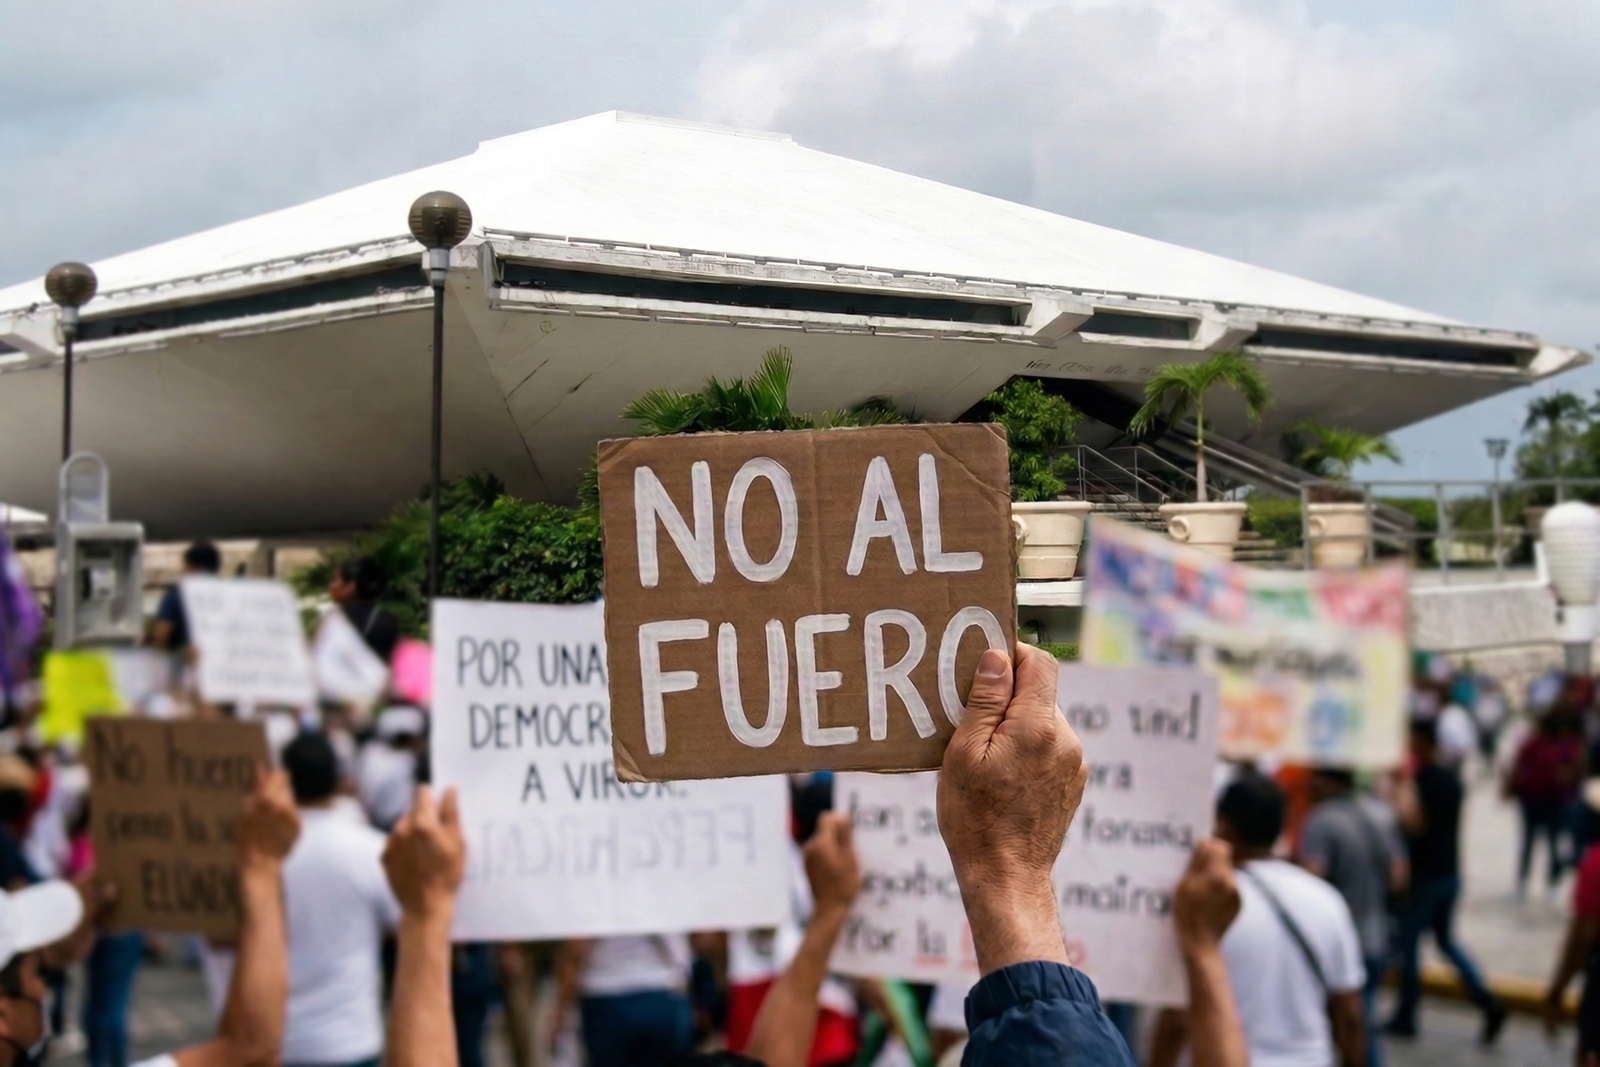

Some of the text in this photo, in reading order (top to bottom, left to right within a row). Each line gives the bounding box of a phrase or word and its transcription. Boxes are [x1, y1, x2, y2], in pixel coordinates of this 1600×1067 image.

[634, 453, 984, 588] NO AL
[457, 634, 607, 688] POR UNA
[638, 606, 1009, 757] FUERO
[521, 760, 547, 803] A
